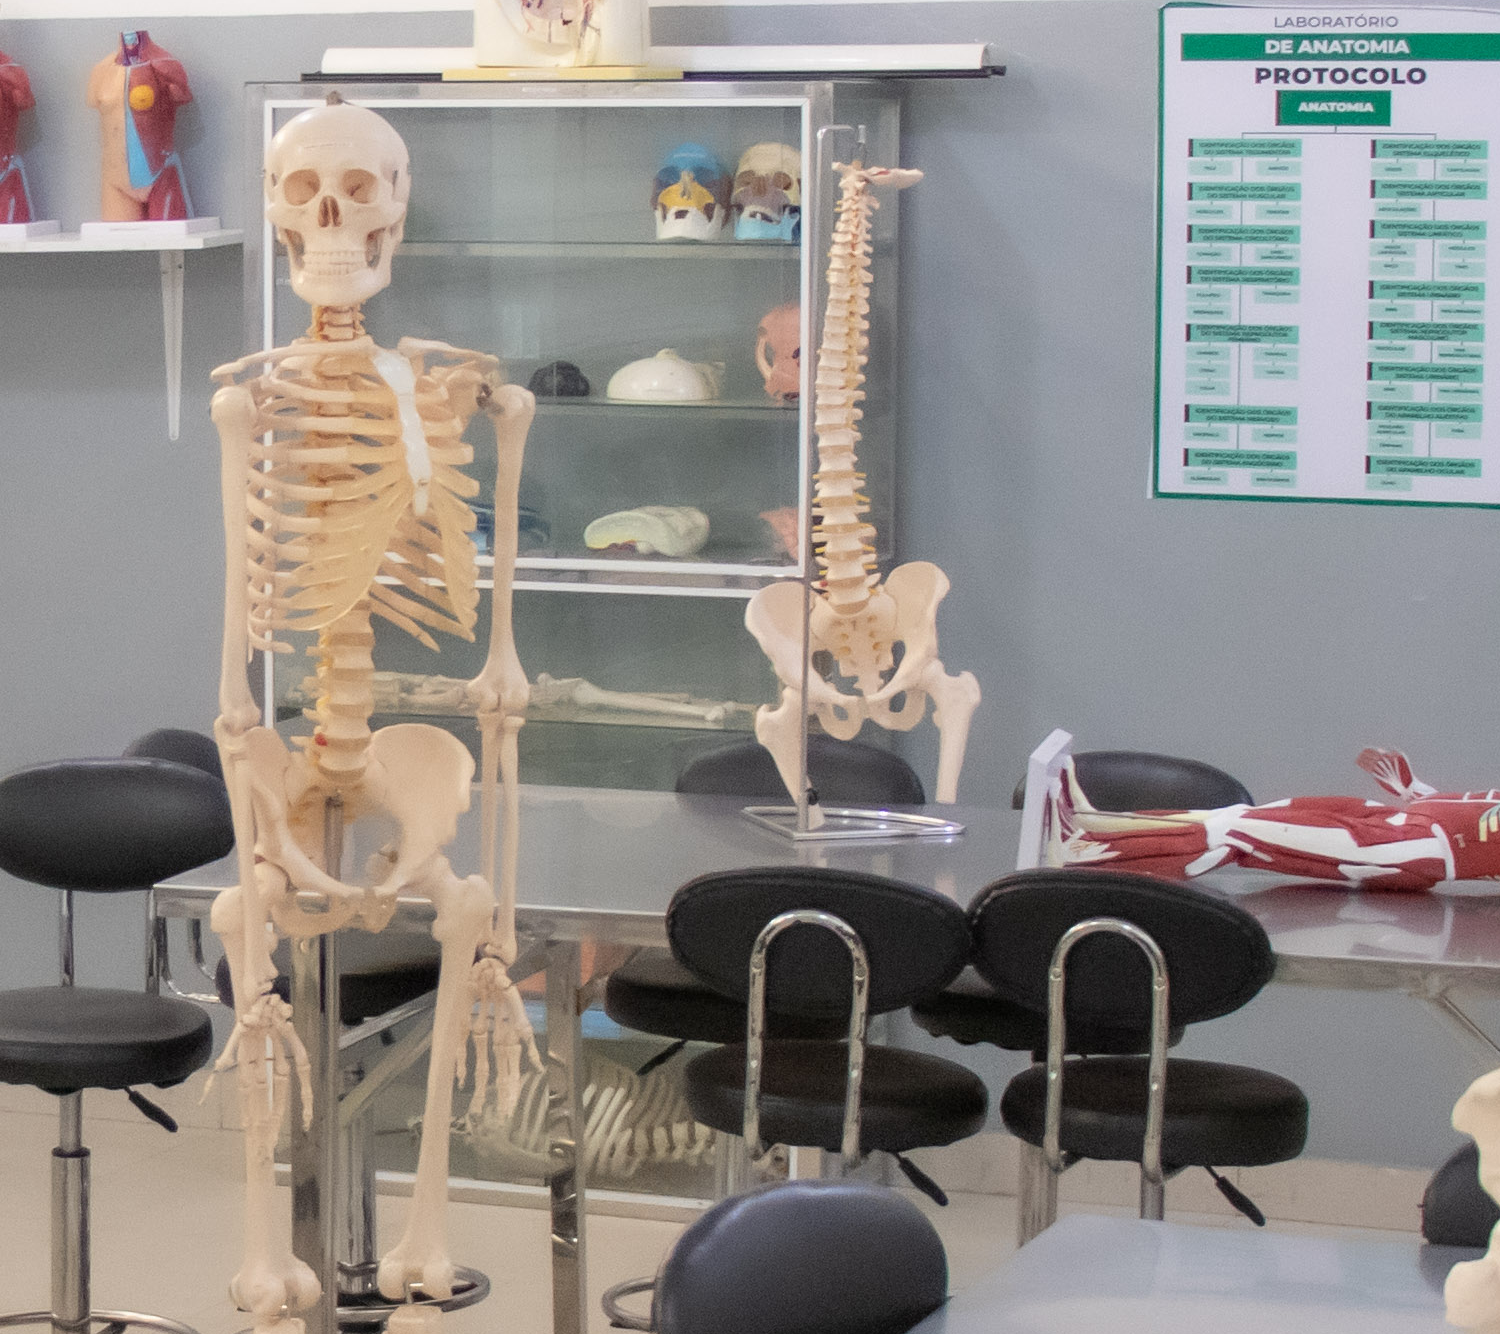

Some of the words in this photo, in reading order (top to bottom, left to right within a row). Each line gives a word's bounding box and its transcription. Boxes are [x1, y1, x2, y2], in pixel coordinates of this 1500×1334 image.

[1274, 14, 1399, 28] LABORATÓRIO
[1265, 39, 1294, 54] DE
[1297, 39, 1410, 54] ANATOMIA
[1255, 67, 1427, 85] PROTOCOLO
[1298, 102, 1375, 112] ANATOMIA
